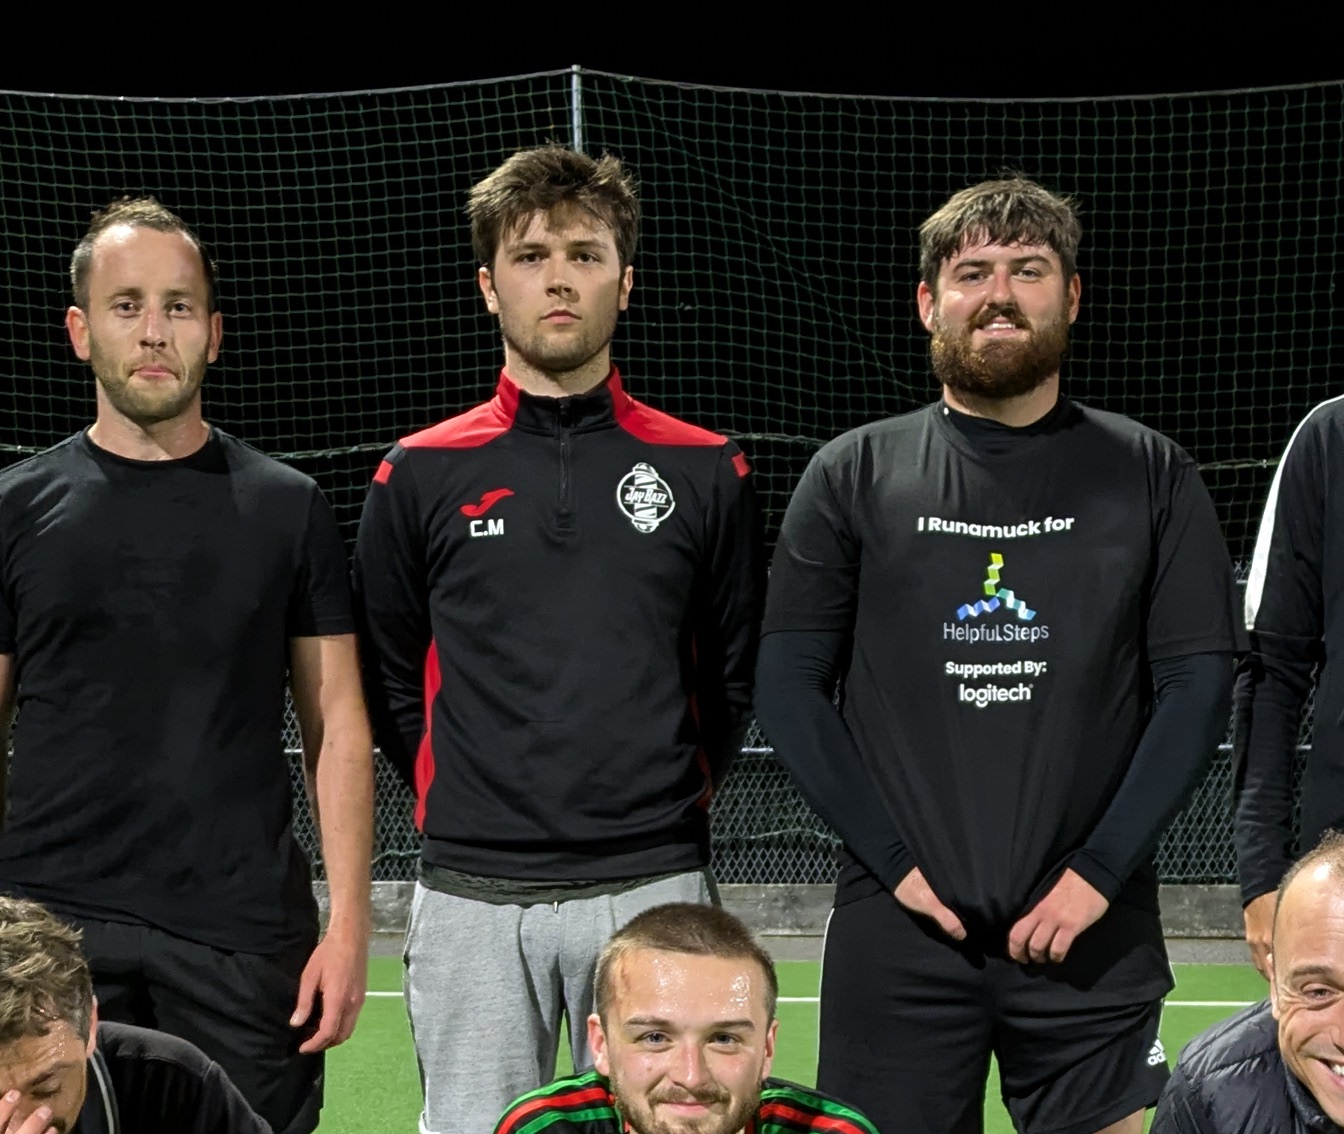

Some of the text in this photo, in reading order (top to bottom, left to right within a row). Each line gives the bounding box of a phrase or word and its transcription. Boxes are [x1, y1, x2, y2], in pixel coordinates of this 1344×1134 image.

[469, 518, 505, 537] C.M
[917, 516, 1076, 539] I Runamuck for
[945, 660, 1048, 679] Supported By:
[959, 683, 1032, 708] logitech
